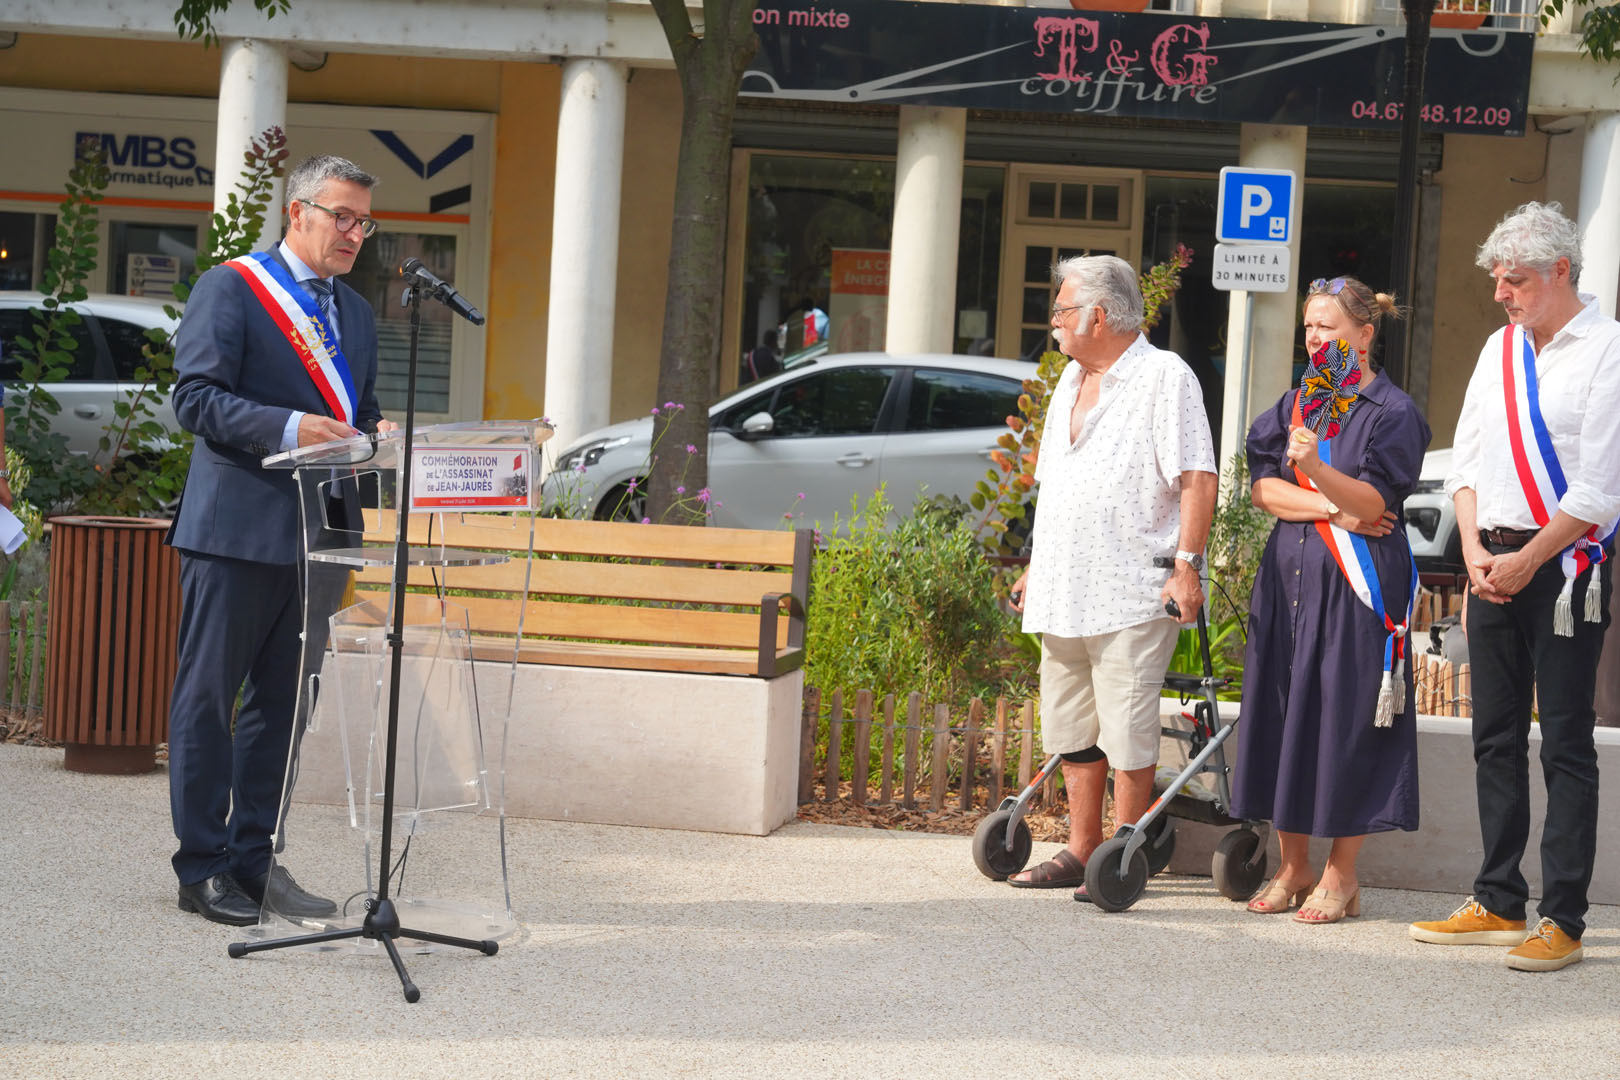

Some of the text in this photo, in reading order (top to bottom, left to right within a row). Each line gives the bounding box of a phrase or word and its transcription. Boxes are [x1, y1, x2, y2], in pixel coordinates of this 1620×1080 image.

[788, 6, 850, 28] mixte
[1034, 16, 1218, 97] T & G
[1020, 67, 1217, 113] coiffure
[1351, 100, 1511, 126] 04.648.12.09
[1240, 184, 1272, 229] P
[1224, 253, 1279, 265] LIMITÉ À
[1216, 271, 1286, 283] 30 MINUTES
[421, 454, 498, 467] COMMÉMORATION
[434, 468, 493, 479] L'ASSASSINAT
[435, 479, 493, 492] JEAN-JAURÈS
